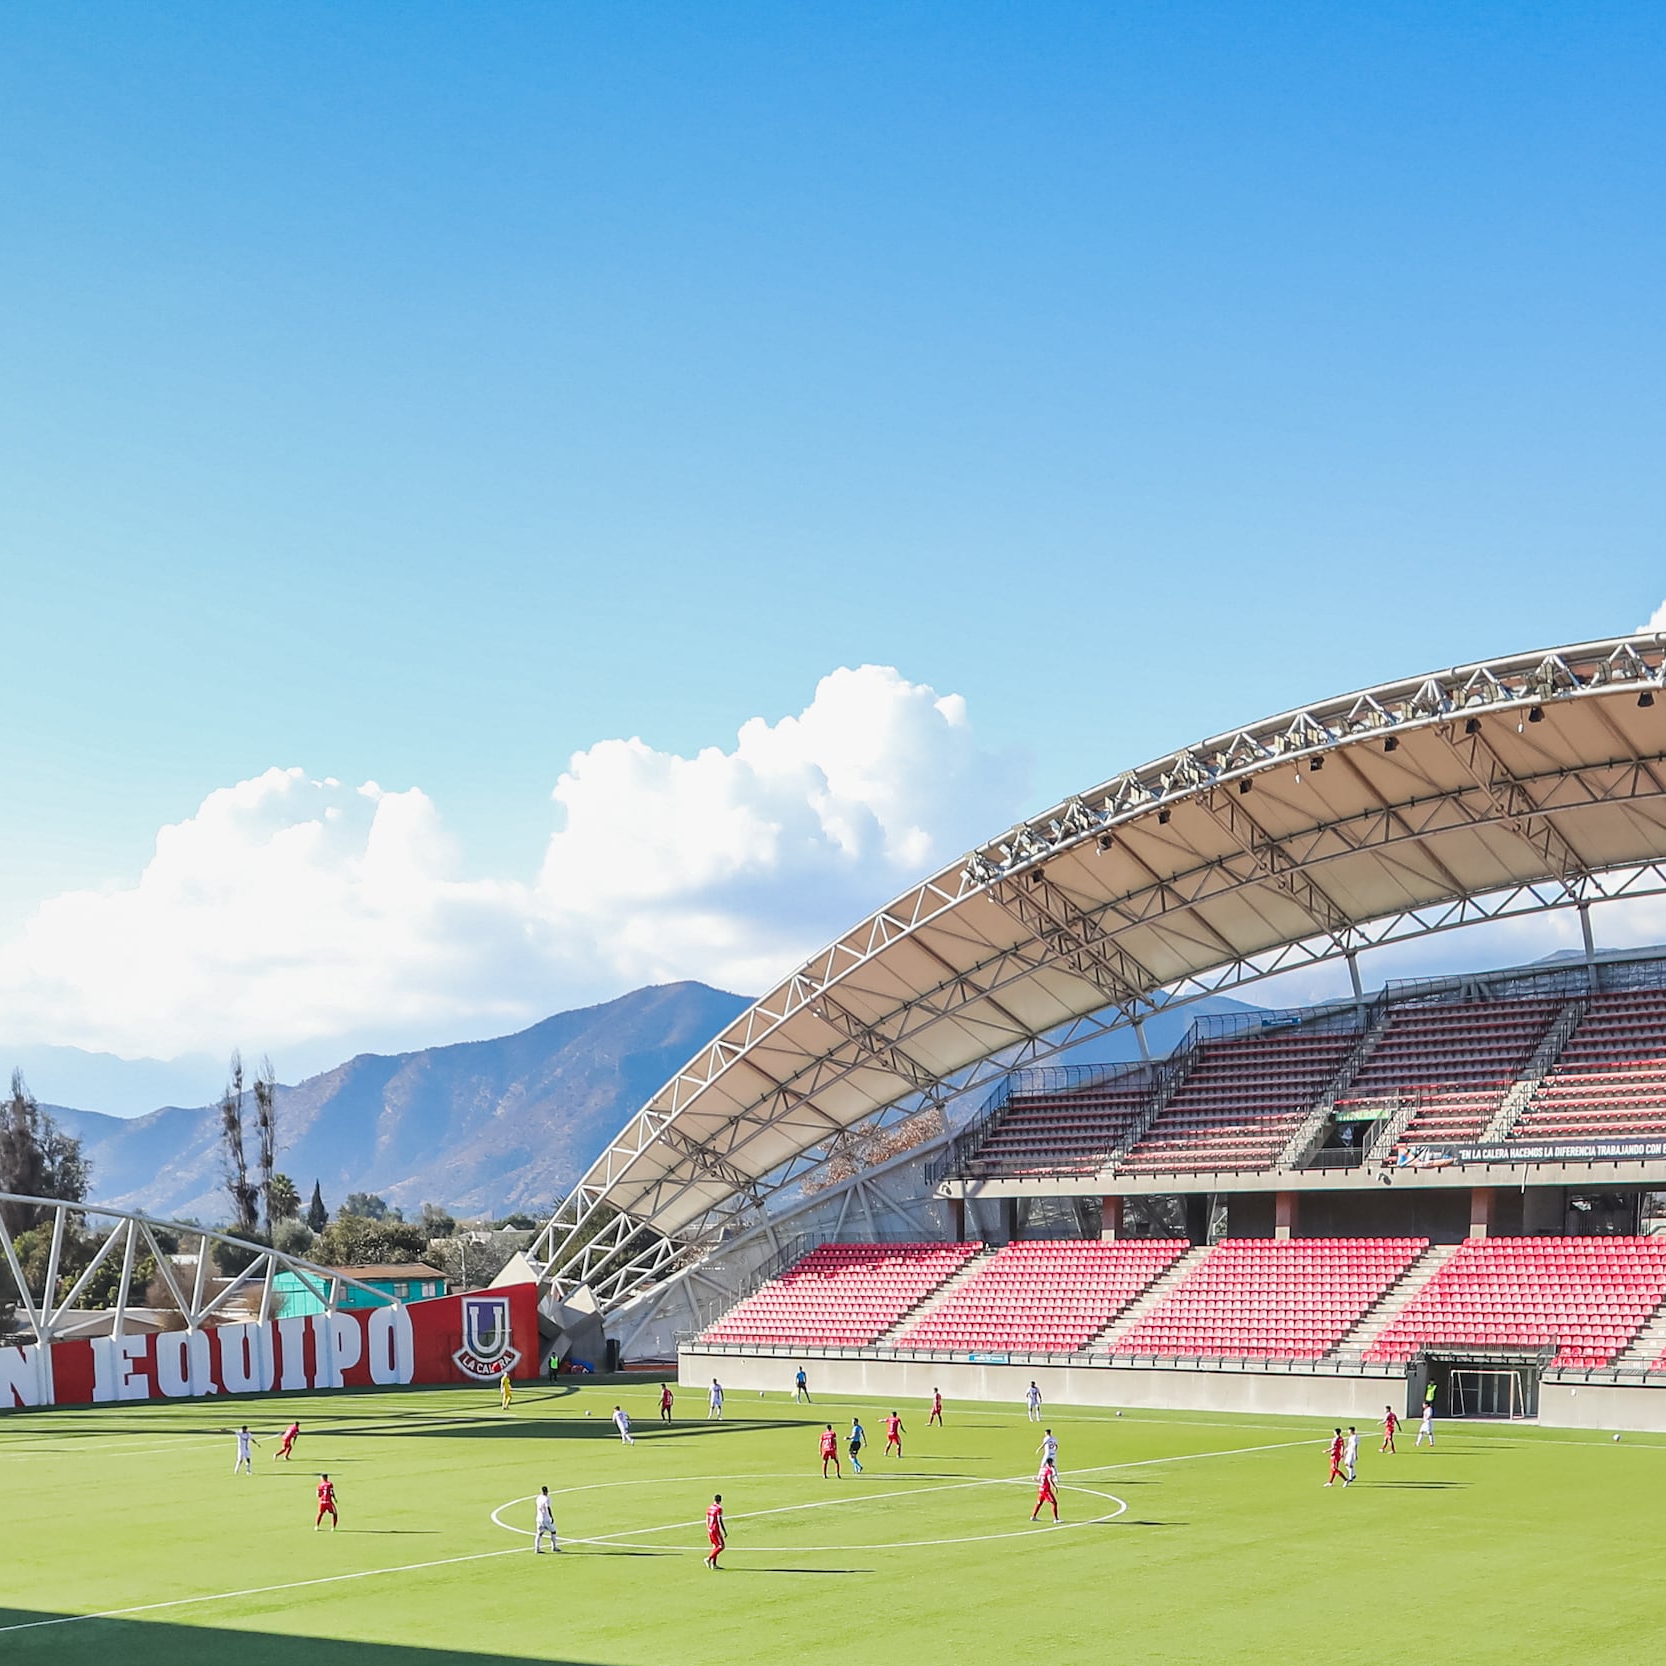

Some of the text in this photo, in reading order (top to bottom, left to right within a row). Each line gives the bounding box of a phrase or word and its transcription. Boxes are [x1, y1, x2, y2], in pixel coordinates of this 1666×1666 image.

[1472, 1149, 1483, 1159] LA
[1483, 1148, 1509, 1159] CALERA
[1510, 1148, 1543, 1158] HACEMOS
[1543, 1147, 1554, 1158] LA
[1555, 1146, 1597, 1157] DIFERENCIA
[1597, 1144, 1644, 1156] TRABAJANDO
[1646, 1143, 1662, 1154] CON
[469, 1306, 503, 1353] U
[90, 1305, 415, 1404] EQUIPO
[462, 1355, 476, 1370] LA
